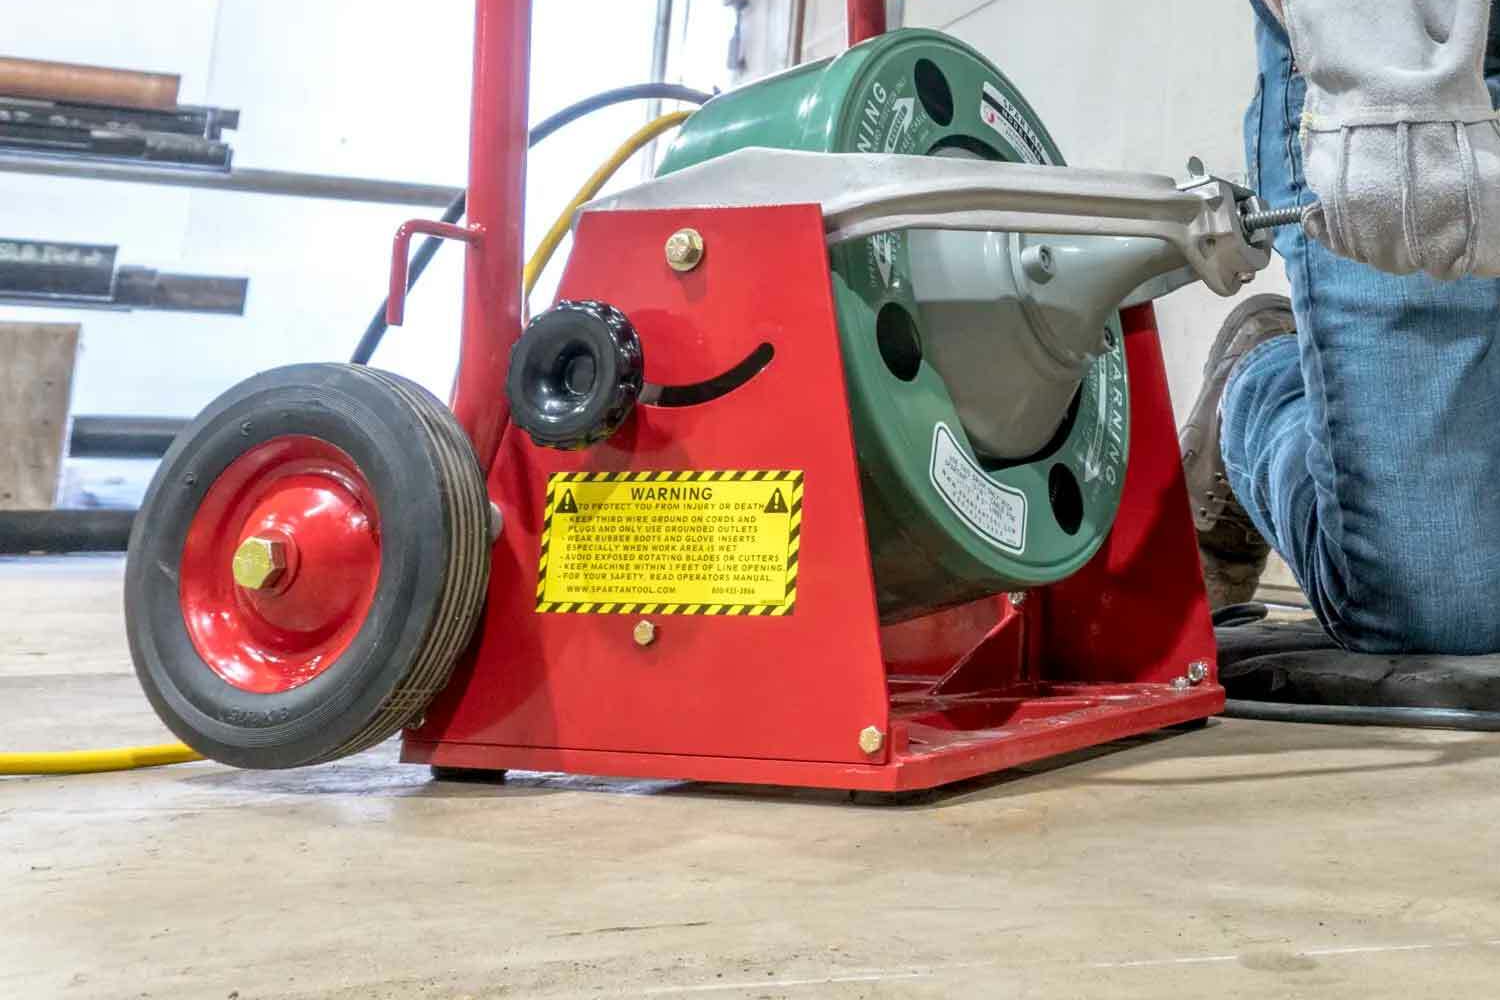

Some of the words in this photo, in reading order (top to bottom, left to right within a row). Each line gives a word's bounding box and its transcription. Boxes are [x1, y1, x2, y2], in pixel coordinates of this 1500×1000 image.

[857, 82, 887, 153] NING
[631, 487, 713, 501] WARNING
[578, 503, 590, 511] TO
[591, 503, 631, 511] PROTECT
[635, 503, 652, 511] YOU
[655, 503, 680, 511] FROM
[683, 503, 714, 511] INJURY
[719, 503, 731, 511] OR
[734, 503, 765, 511] DEATH
[596, 515, 623, 523] THIRD
[625, 515, 648, 523] WIRE
[650, 515, 689, 523] GROUND
[690, 515, 703, 523] ON
[705, 515, 734, 523] CORDS
[737, 515, 757, 523] AND
[567, 525, 595, 533] PLUGS
[598, 525, 616, 533] AND
[618, 525, 642, 533] ONLY
[644, 525, 662, 533] USE
[664, 525, 714, 533] GROUNDED
[717, 525, 758, 533] OUTLETS
[595, 535, 631, 543] RUBBER
[634, 535, 661, 543] BOOTS
[664, 535, 682, 543] AND
[684, 535, 714, 543] GLOVE
[566, 544, 619, 552] ESPECIALLY
[622, 544, 649, 552] WHEN
[651, 544, 678, 552] WORK
[680, 544, 704, 552] AREA
[705, 544, 714, 552] IS
[718, 544, 737, 552] WET
[594, 553, 635, 561] EXPOSED
[638, 553, 683, 562] ROTATING
[685, 554, 720, 562] BLADES
[723, 554, 735, 562] OR
[590, 563, 631, 571] MACHINE
[633, 563, 666, 572] WITHIN
[675, 564, 698, 572] FEET
[702, 564, 714, 572] OF
[716, 564, 738, 572] LINE
[583, 572, 607, 580] YOUR
[649, 572, 674, 581] READ
[676, 573, 730, 581] OPERATORS
[566, 585, 676, 594] WWW.SPARTANTOOL.COM
